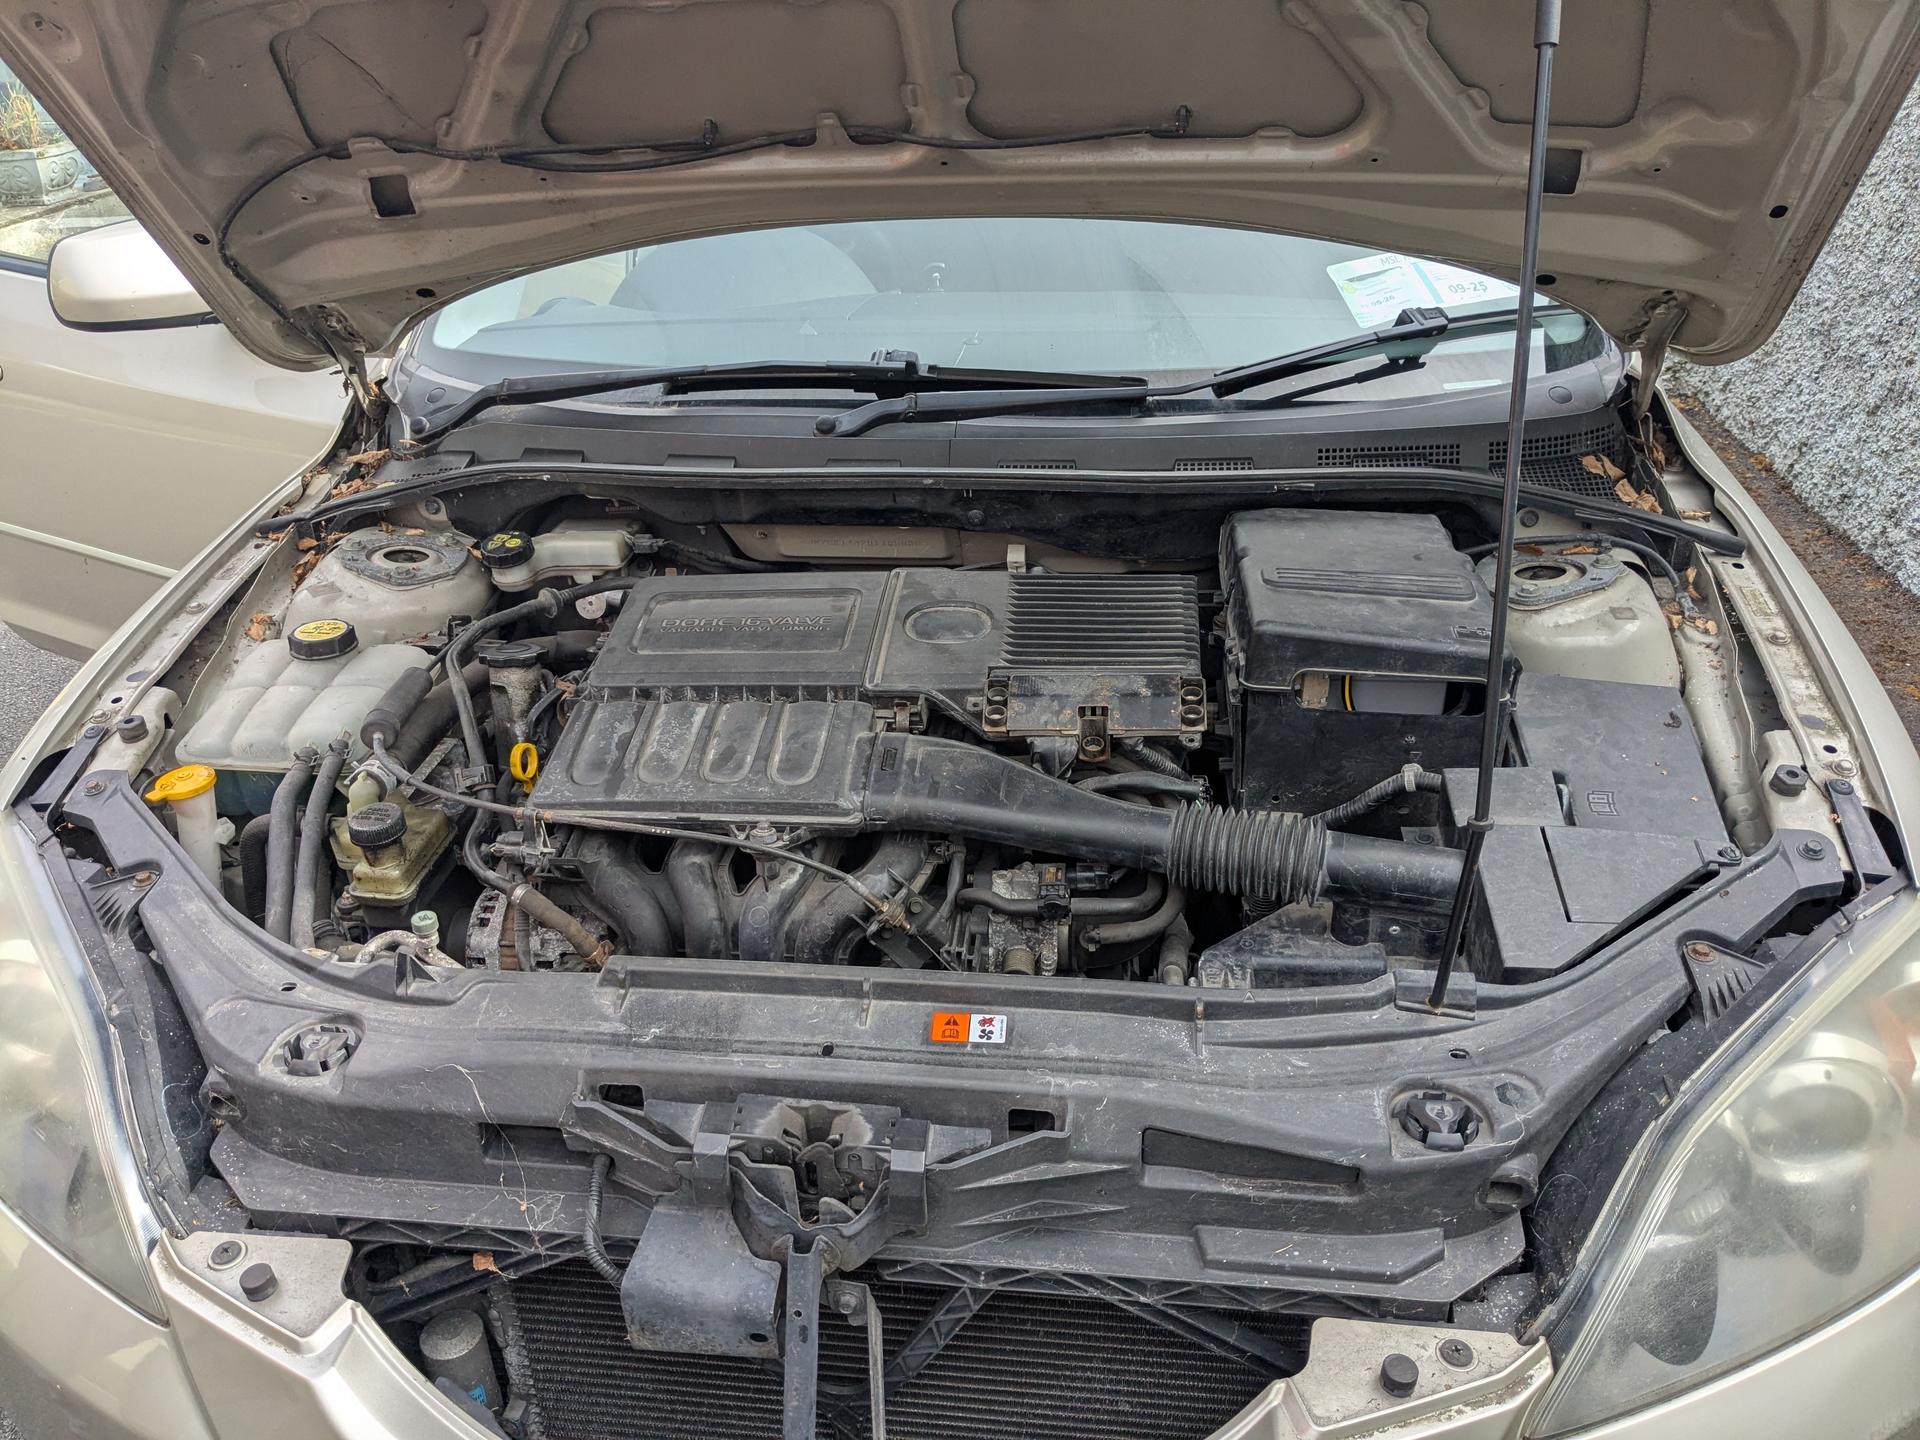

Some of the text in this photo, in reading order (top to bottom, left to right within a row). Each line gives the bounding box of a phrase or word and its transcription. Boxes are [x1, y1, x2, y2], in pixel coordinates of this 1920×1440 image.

[1448, 281, 1488, 293] 09-25
[661, 616, 833, 627] DOHC 16-VALVE
